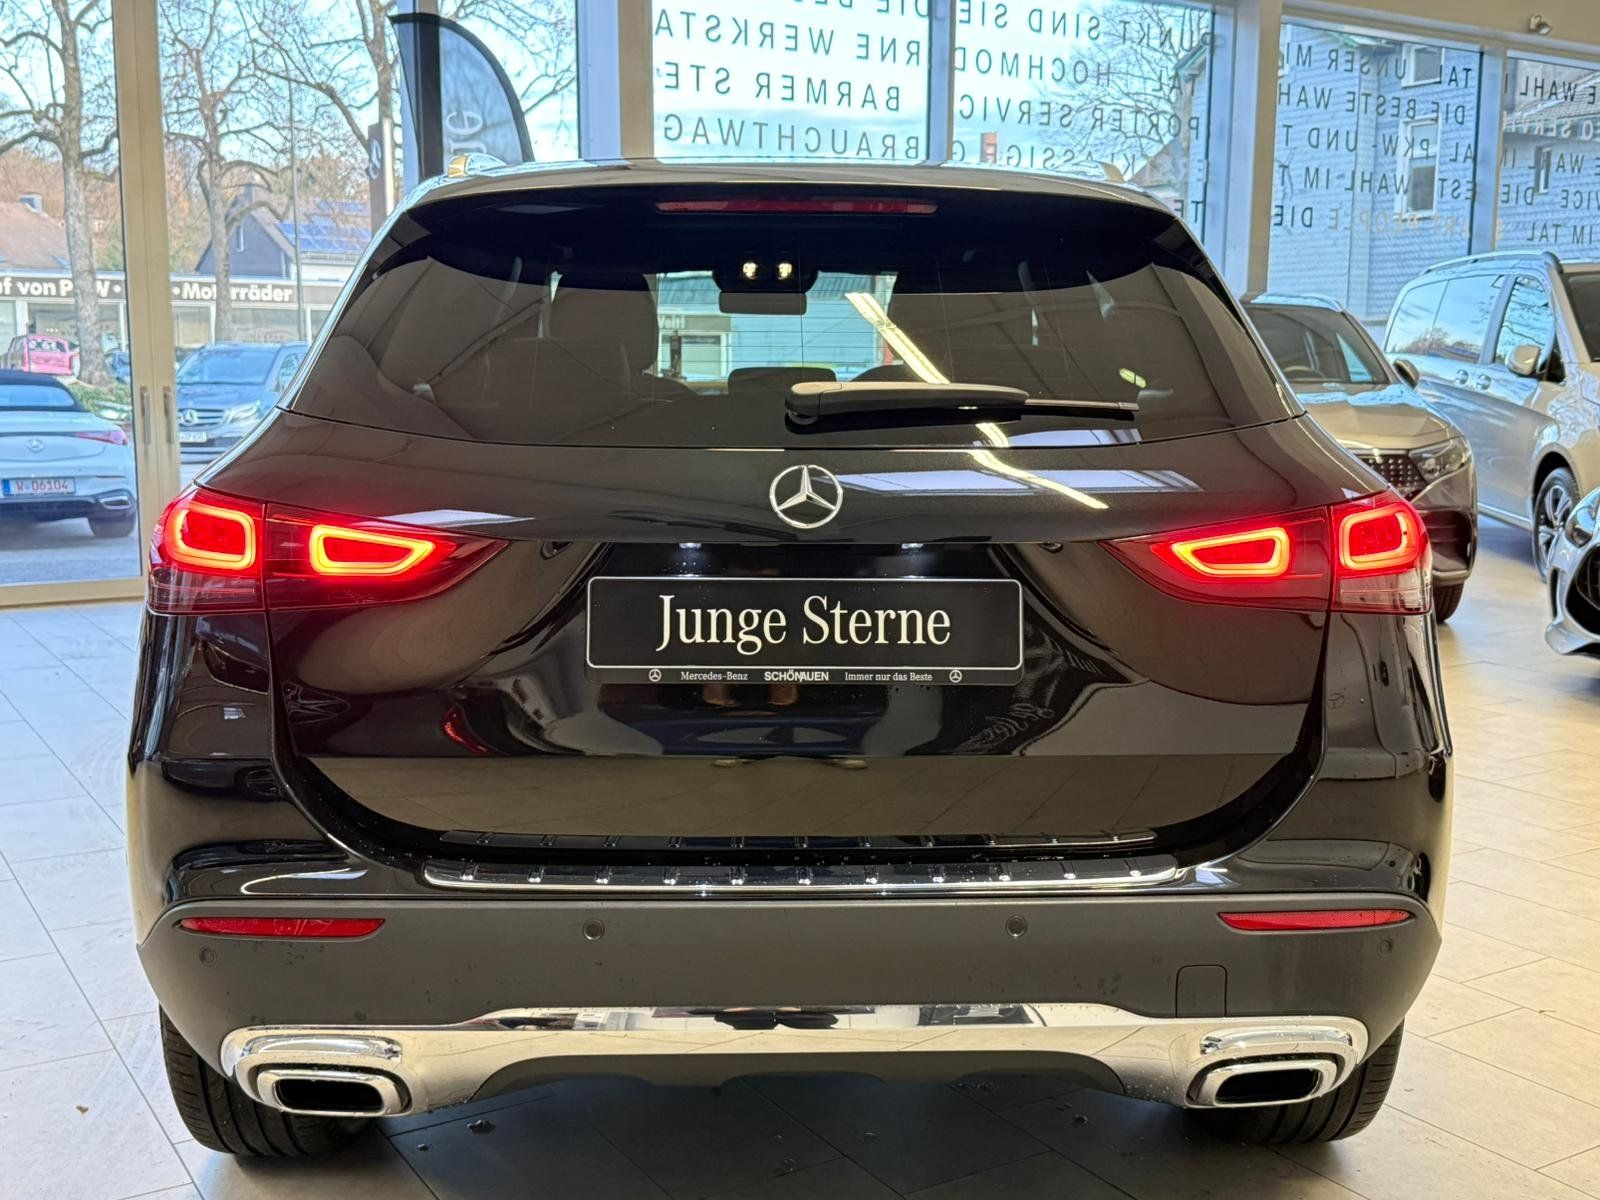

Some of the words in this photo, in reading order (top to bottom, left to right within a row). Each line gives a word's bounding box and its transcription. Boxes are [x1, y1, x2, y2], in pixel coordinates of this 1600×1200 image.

[16, 281, 57, 296] von
[59, 279, 110, 298] PW
[181, 281, 293, 302] Motrräder
[655, 594, 787, 656] Junge
[802, 595, 951, 646] Sterne
[680, 671, 748, 681] Mercedes-Benz
[764, 669, 829, 682] SCHÖNAUEN
[844, 672, 874, 681] Immer
[875, 673, 891, 681] nur
[892, 672, 908, 681] das
[910, 672, 933, 681] Beste
